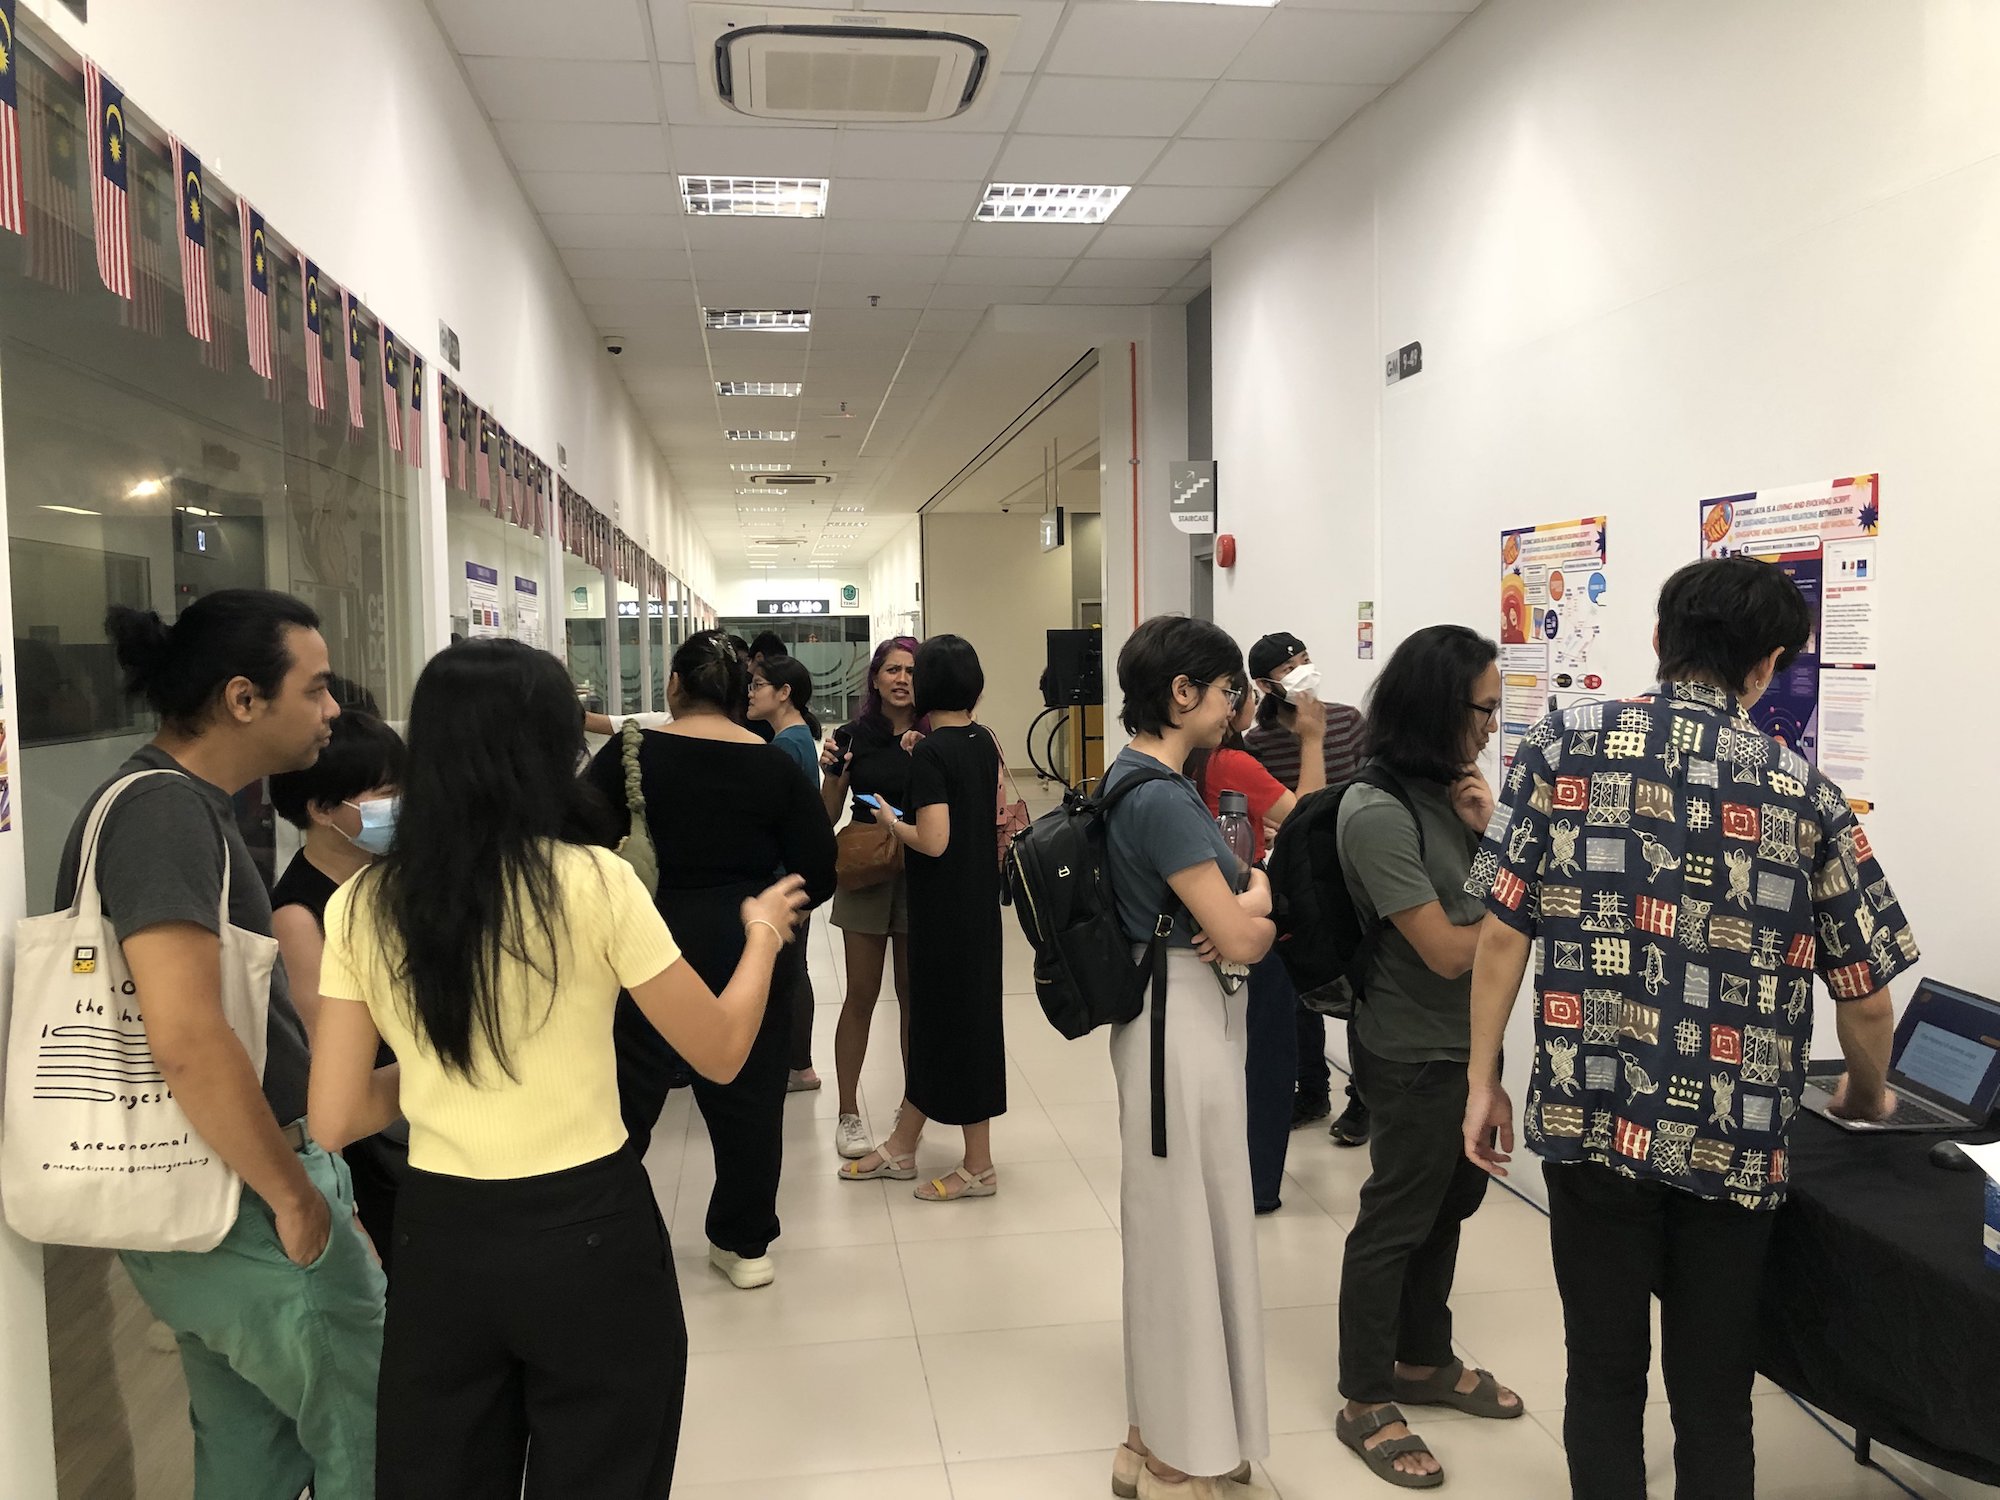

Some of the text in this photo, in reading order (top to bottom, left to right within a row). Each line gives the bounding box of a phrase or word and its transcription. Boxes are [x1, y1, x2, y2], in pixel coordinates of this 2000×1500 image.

[1766, 505, 1772, 513] IS
[1793, 500, 1805, 509] AND
[1818, 507, 1842, 518] BETWEEN
[1843, 506, 1854, 514] THE
[75, 998, 104, 1015] the
